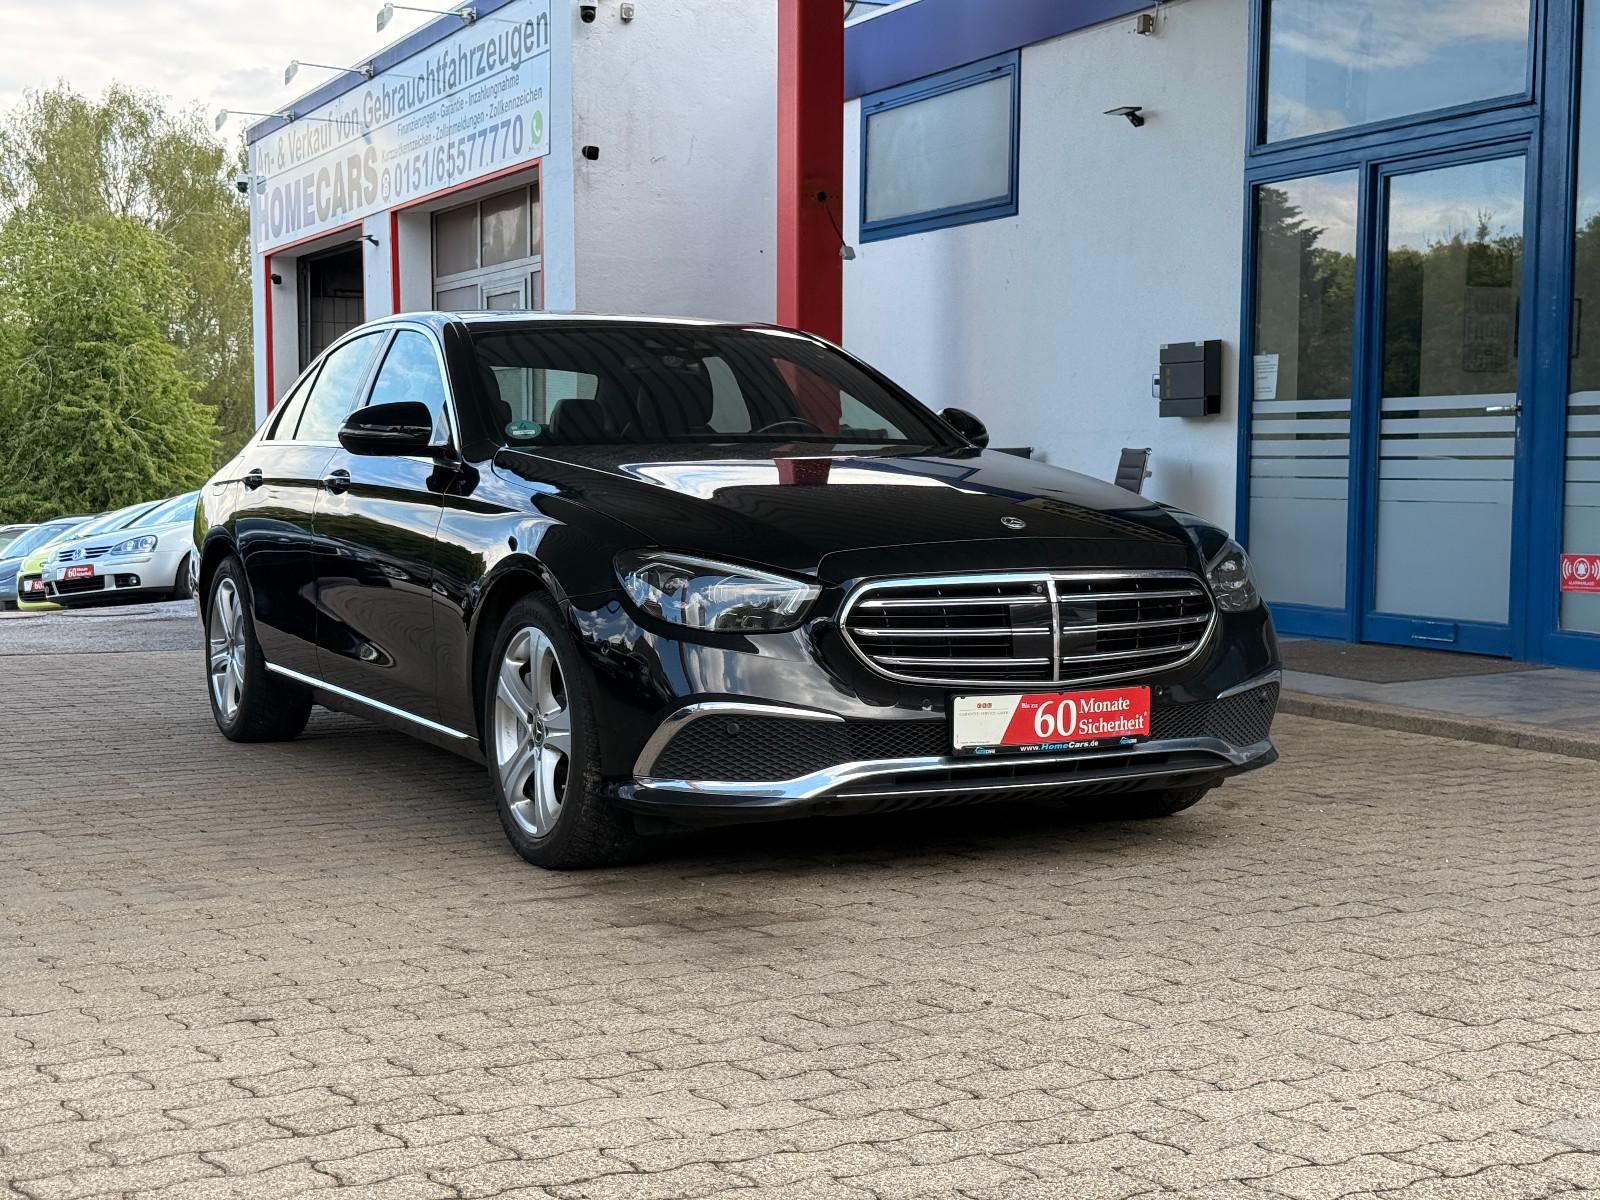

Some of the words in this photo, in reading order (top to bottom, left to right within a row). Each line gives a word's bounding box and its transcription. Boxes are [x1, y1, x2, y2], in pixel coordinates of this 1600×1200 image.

[277, 135, 286, 170] &
[288, 110, 333, 165] Verkauf
[335, 106, 359, 142] von
[363, 11, 548, 129] Gebrauchtfahrzeugen
[397, 111, 437, 137] Finanzierungen
[440, 98, 465, 119] Garantie
[394, 114, 524, 198] 0151/65577770
[1034, 699, 1077, 738] 60
[1079, 697, 1130, 714] Monate
[1020, 740, 1099, 752] www.HomeCars.de
